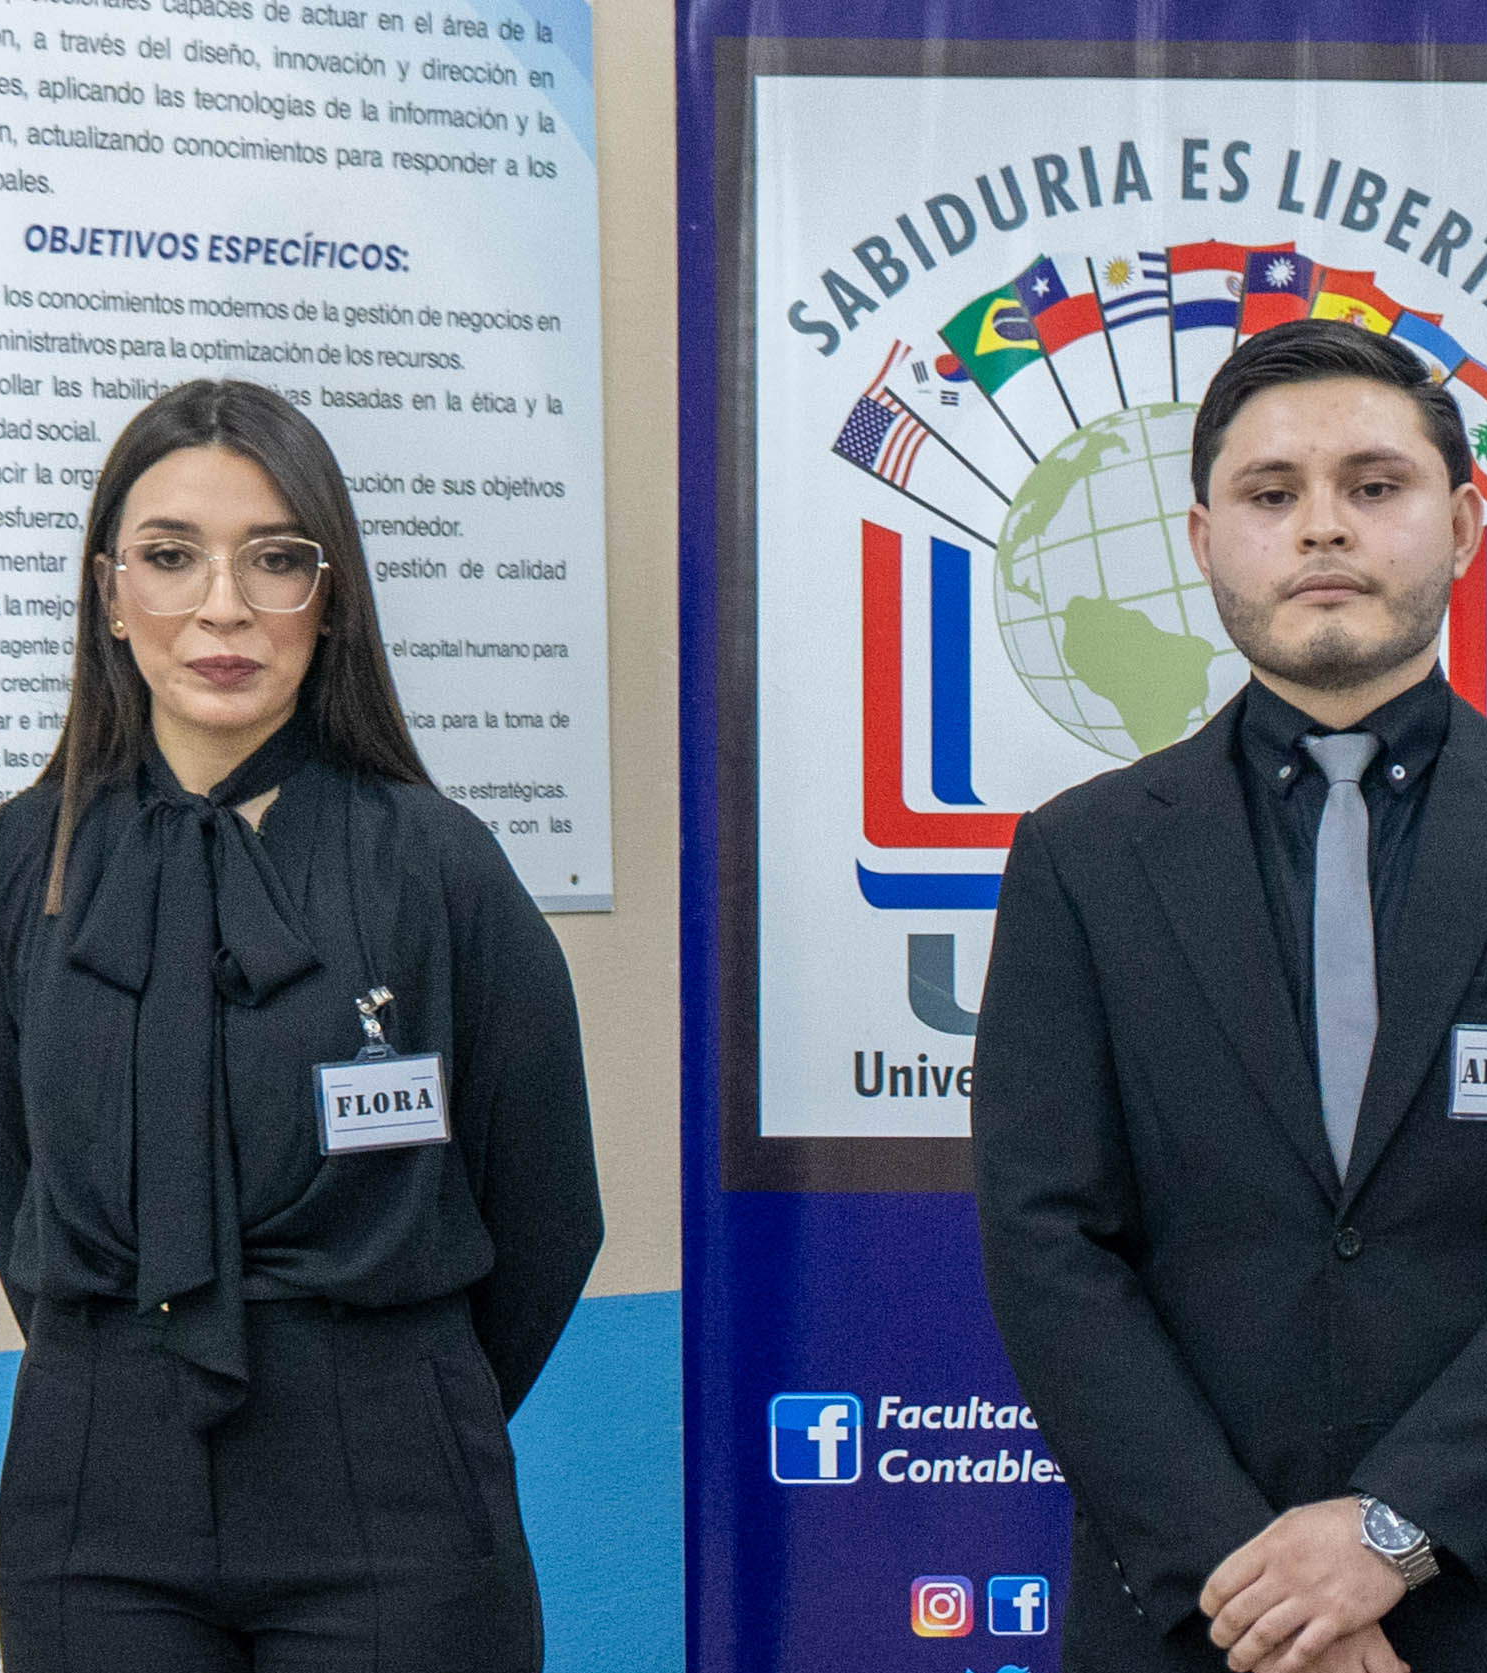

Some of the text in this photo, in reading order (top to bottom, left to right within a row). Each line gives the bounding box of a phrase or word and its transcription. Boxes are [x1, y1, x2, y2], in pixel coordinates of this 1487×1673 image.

[23, 224, 410, 273] OBJETIVOS ESPECÍFICOS:
[788, 141, 1153, 357] SABIDURIA
[1182, 138, 1250, 203] ES
[2, 285, 34, 308] los
[36, 290, 186, 315] conocimientos
[187, 296, 290, 320] modernos
[291, 300, 319, 322] de
[322, 300, 341, 322] la
[342, 303, 415, 328] gestión
[416, 306, 443, 327] de
[446, 309, 534, 333] negocios
[536, 315, 562, 332] en
[35, 421, 102, 443] social.
[377, 558, 567, 583] gestión de calidad
[394, 639, 570, 661] el capital humano para
[854, 1051, 973, 1098] Unive
[337, 1088, 434, 1118] FLORA
